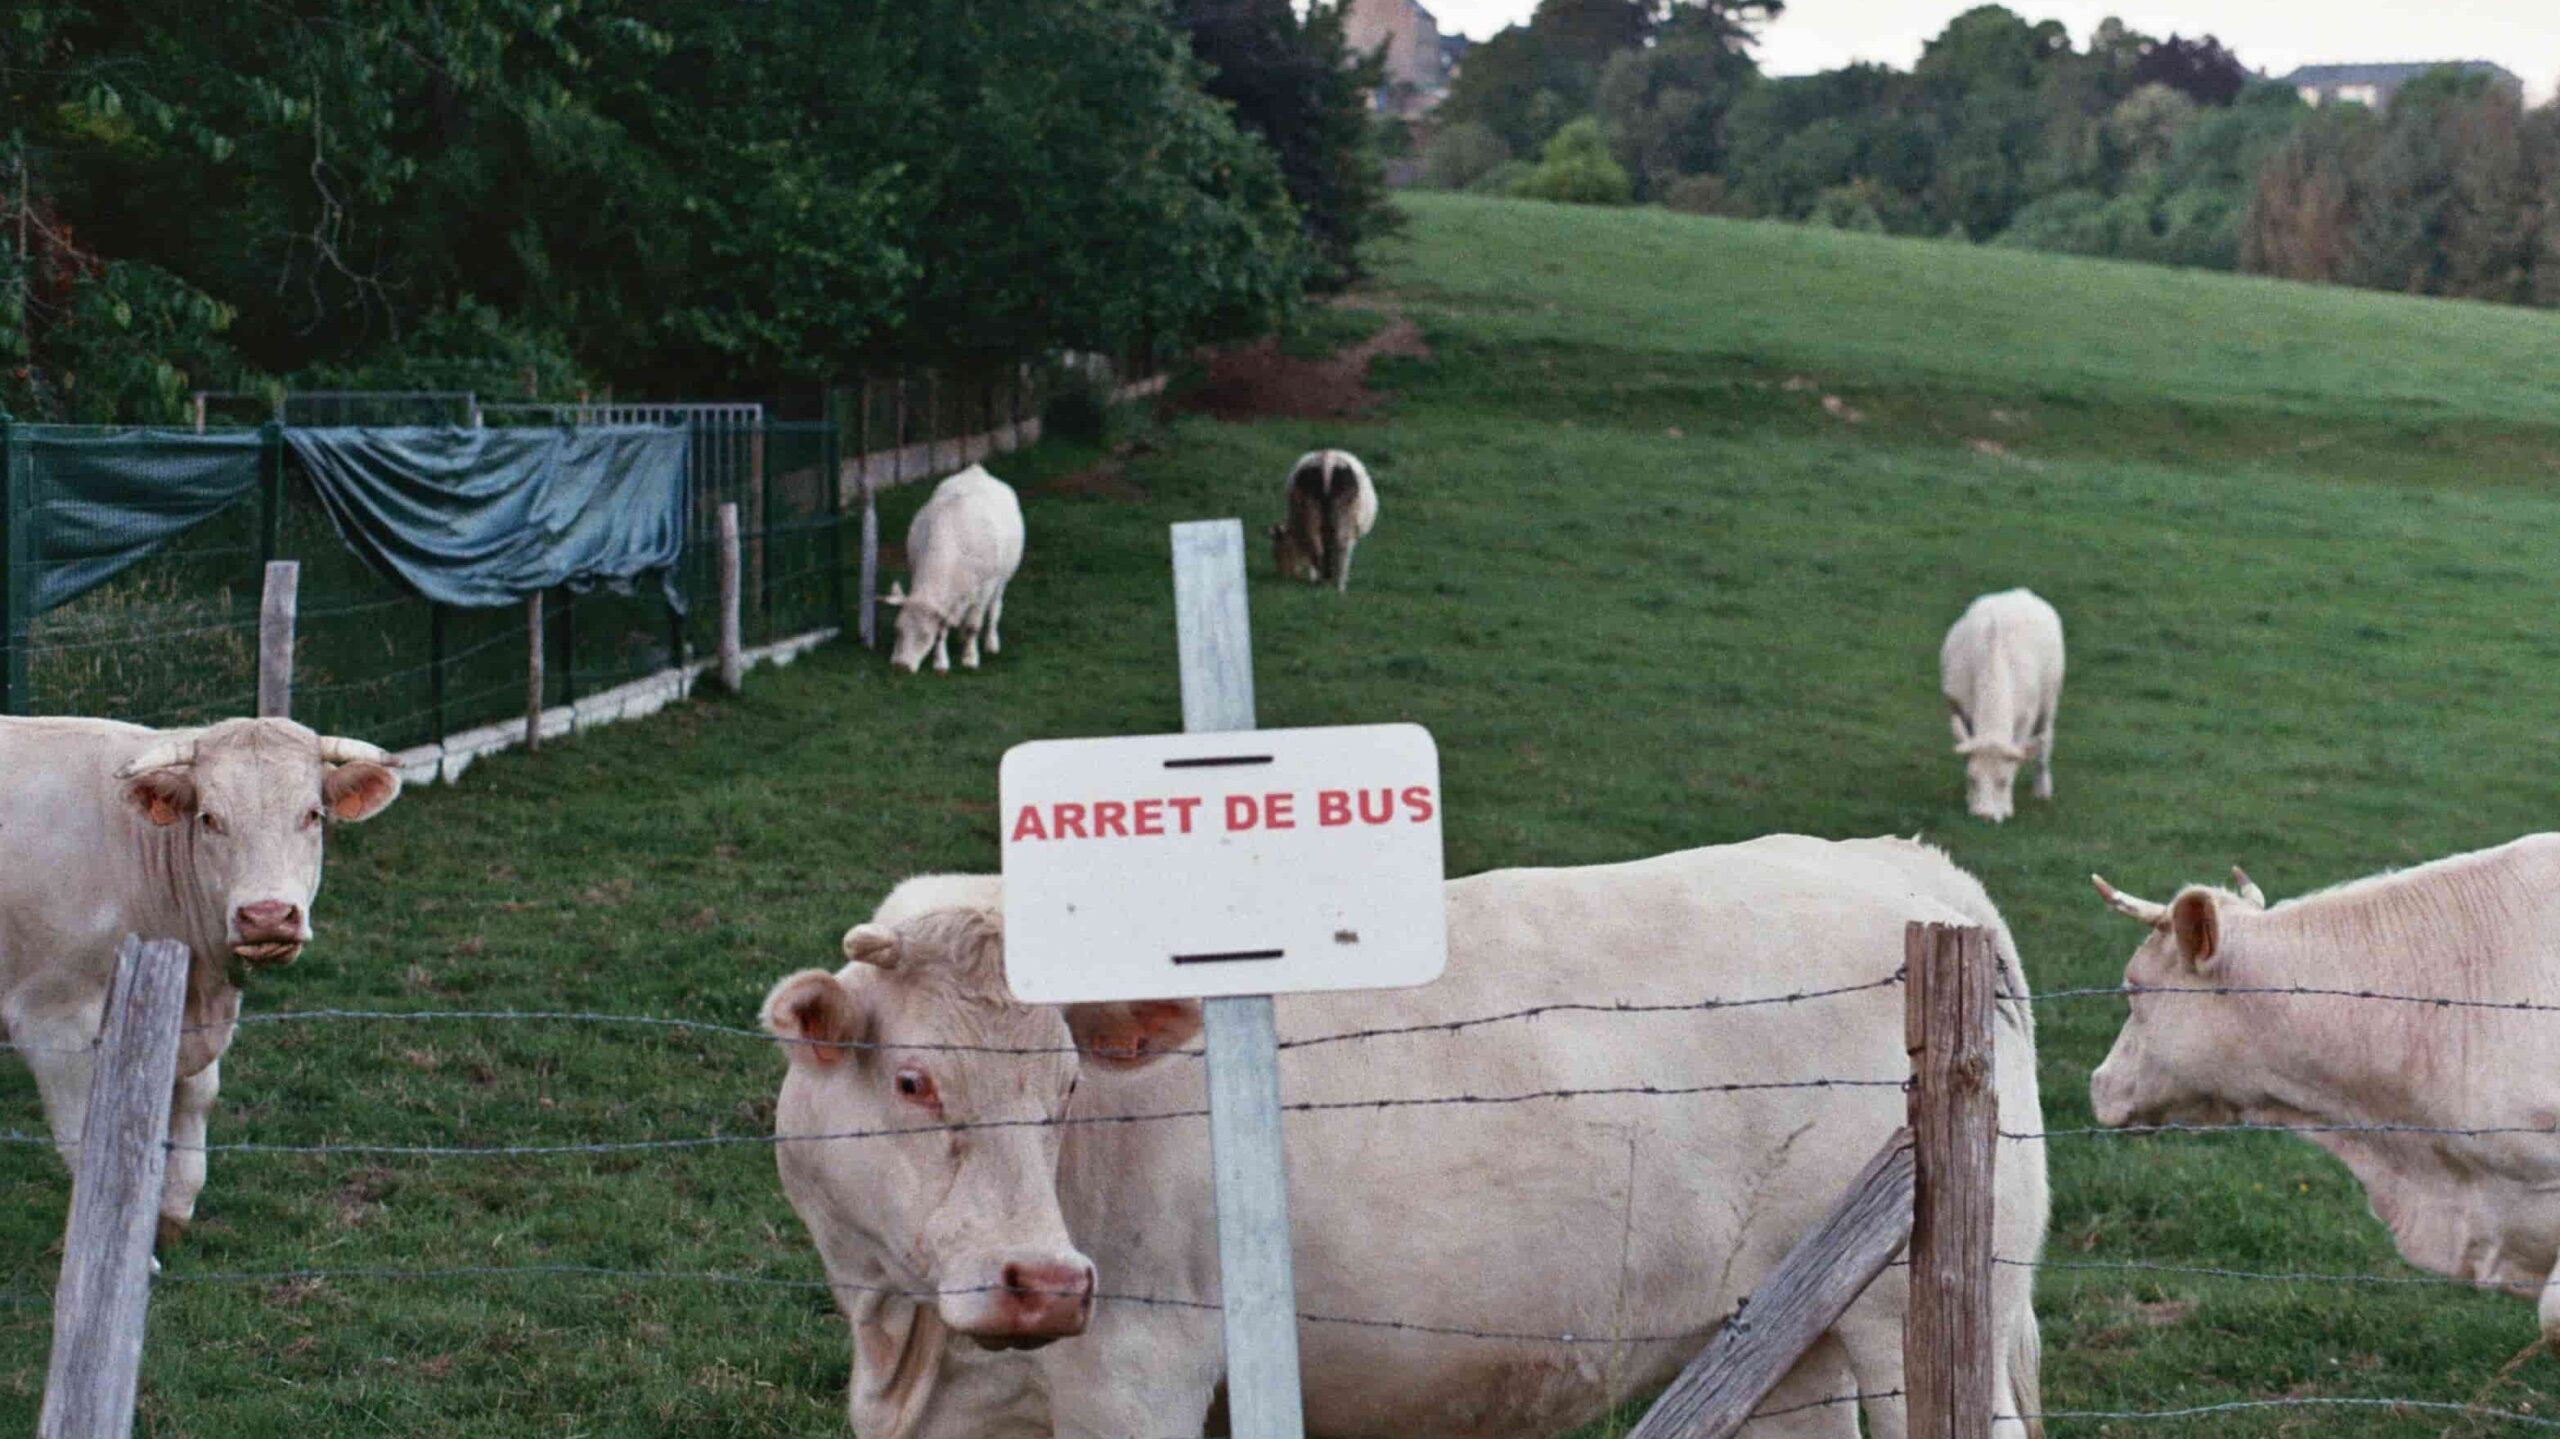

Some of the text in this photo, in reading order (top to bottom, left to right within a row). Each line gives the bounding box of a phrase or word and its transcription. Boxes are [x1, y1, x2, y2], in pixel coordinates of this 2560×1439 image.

[1011, 786, 1434, 842] ARRET DE BUS
